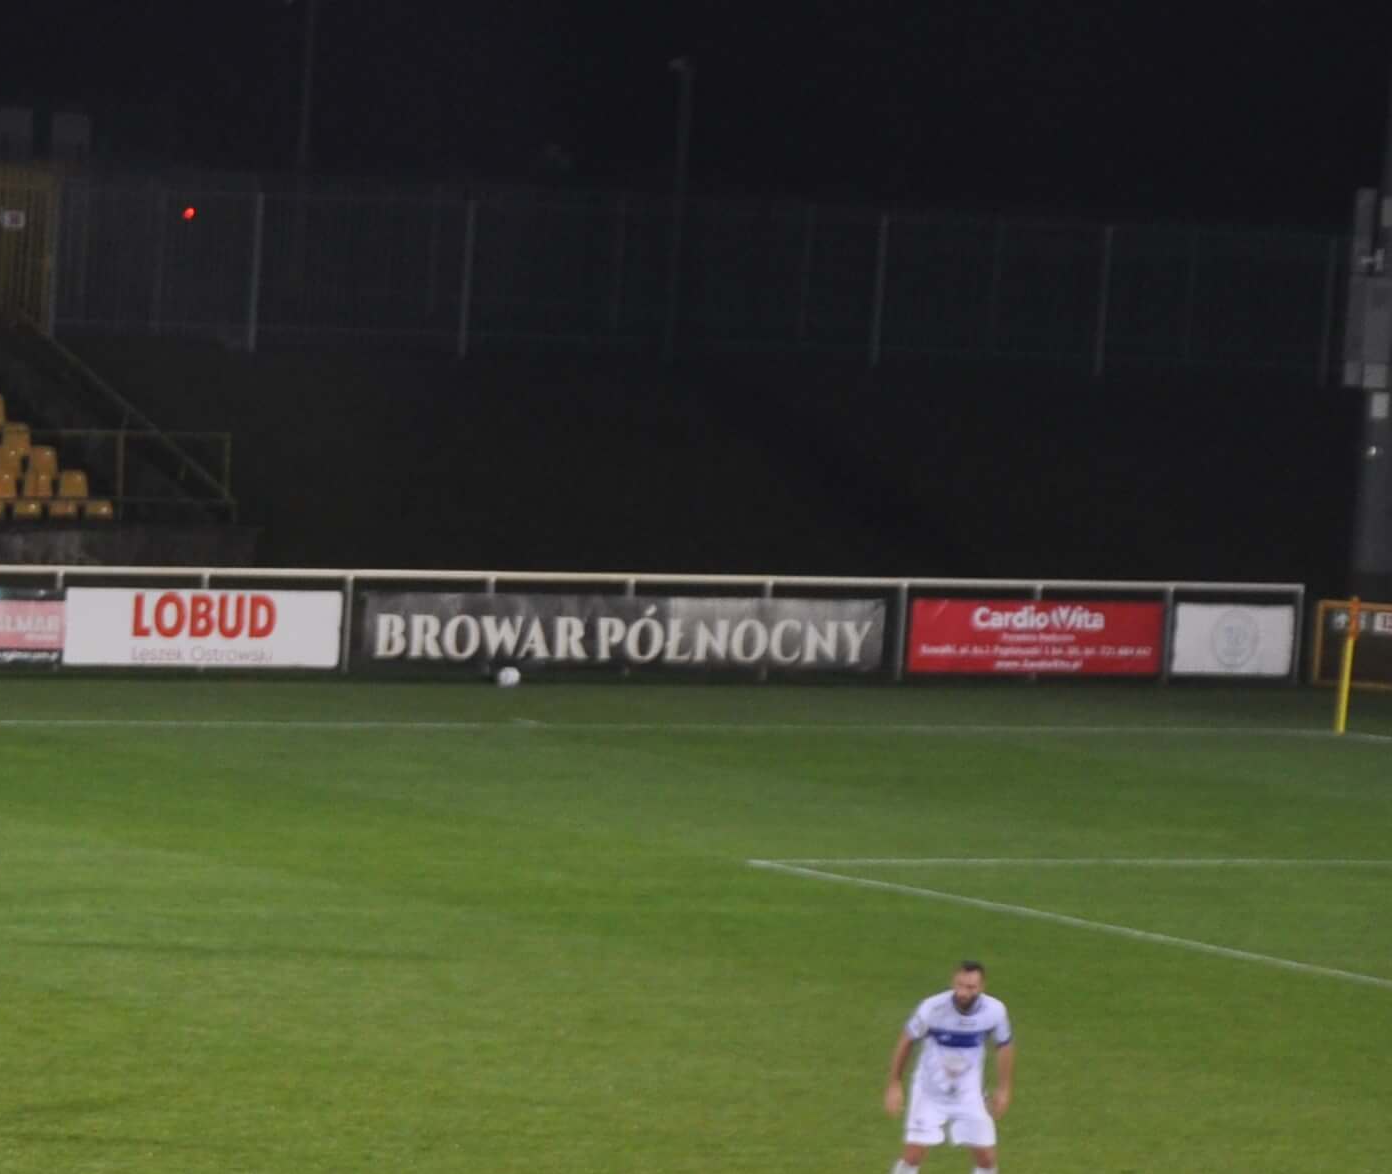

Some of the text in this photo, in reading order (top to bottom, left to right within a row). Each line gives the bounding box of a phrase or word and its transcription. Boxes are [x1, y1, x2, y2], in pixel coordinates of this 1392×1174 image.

[131, 592, 277, 638] LOBUD
[373, 604, 872, 664] BROWAR PÓŁNOCNY
[972, 606, 1049, 630] Cardio
